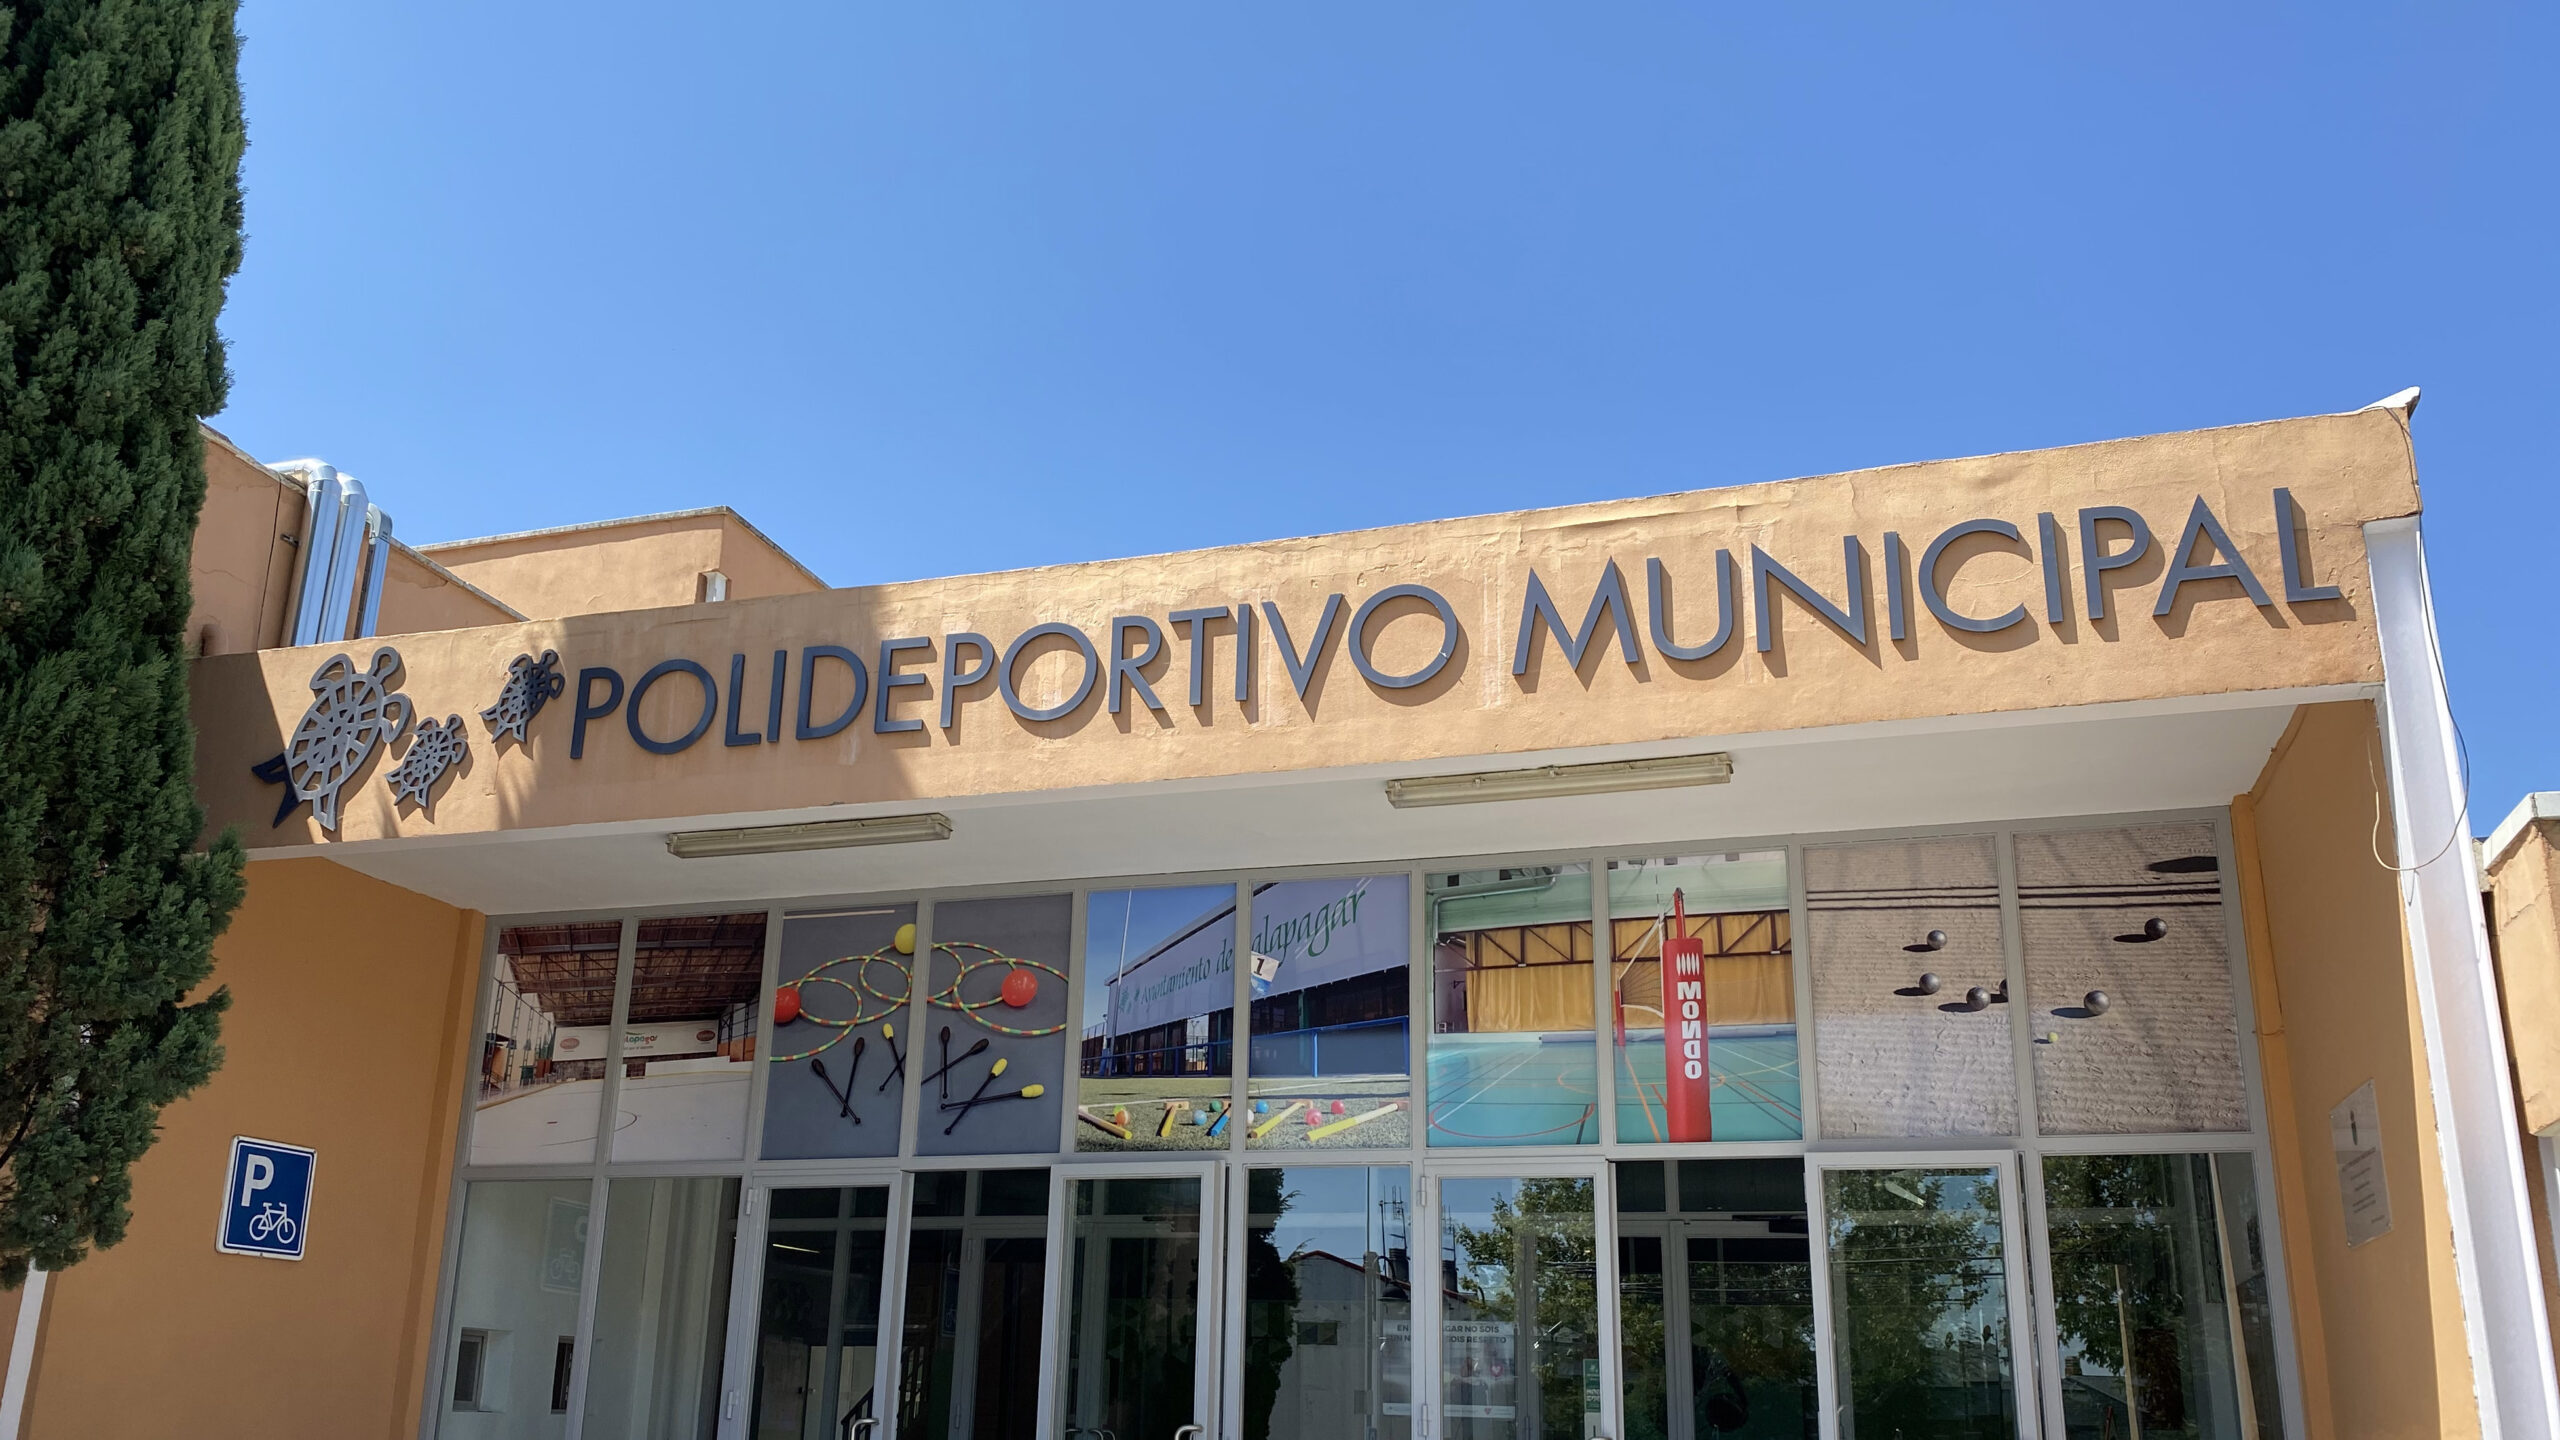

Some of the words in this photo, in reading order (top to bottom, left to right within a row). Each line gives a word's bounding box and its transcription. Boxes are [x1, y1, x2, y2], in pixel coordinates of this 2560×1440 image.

[570, 583, 1459, 760] POLIDEPORTIVO
[1511, 487, 2341, 677] MUNICIPAL
[1216, 938, 1233, 974] de
[1251, 890, 1366, 968] alapagar
[1253, 958, 1266, 977] 1
[241, 1153, 275, 1208] P
[1397, 1324, 1409, 1332] EN
[1464, 1325, 1478, 1333] NO
